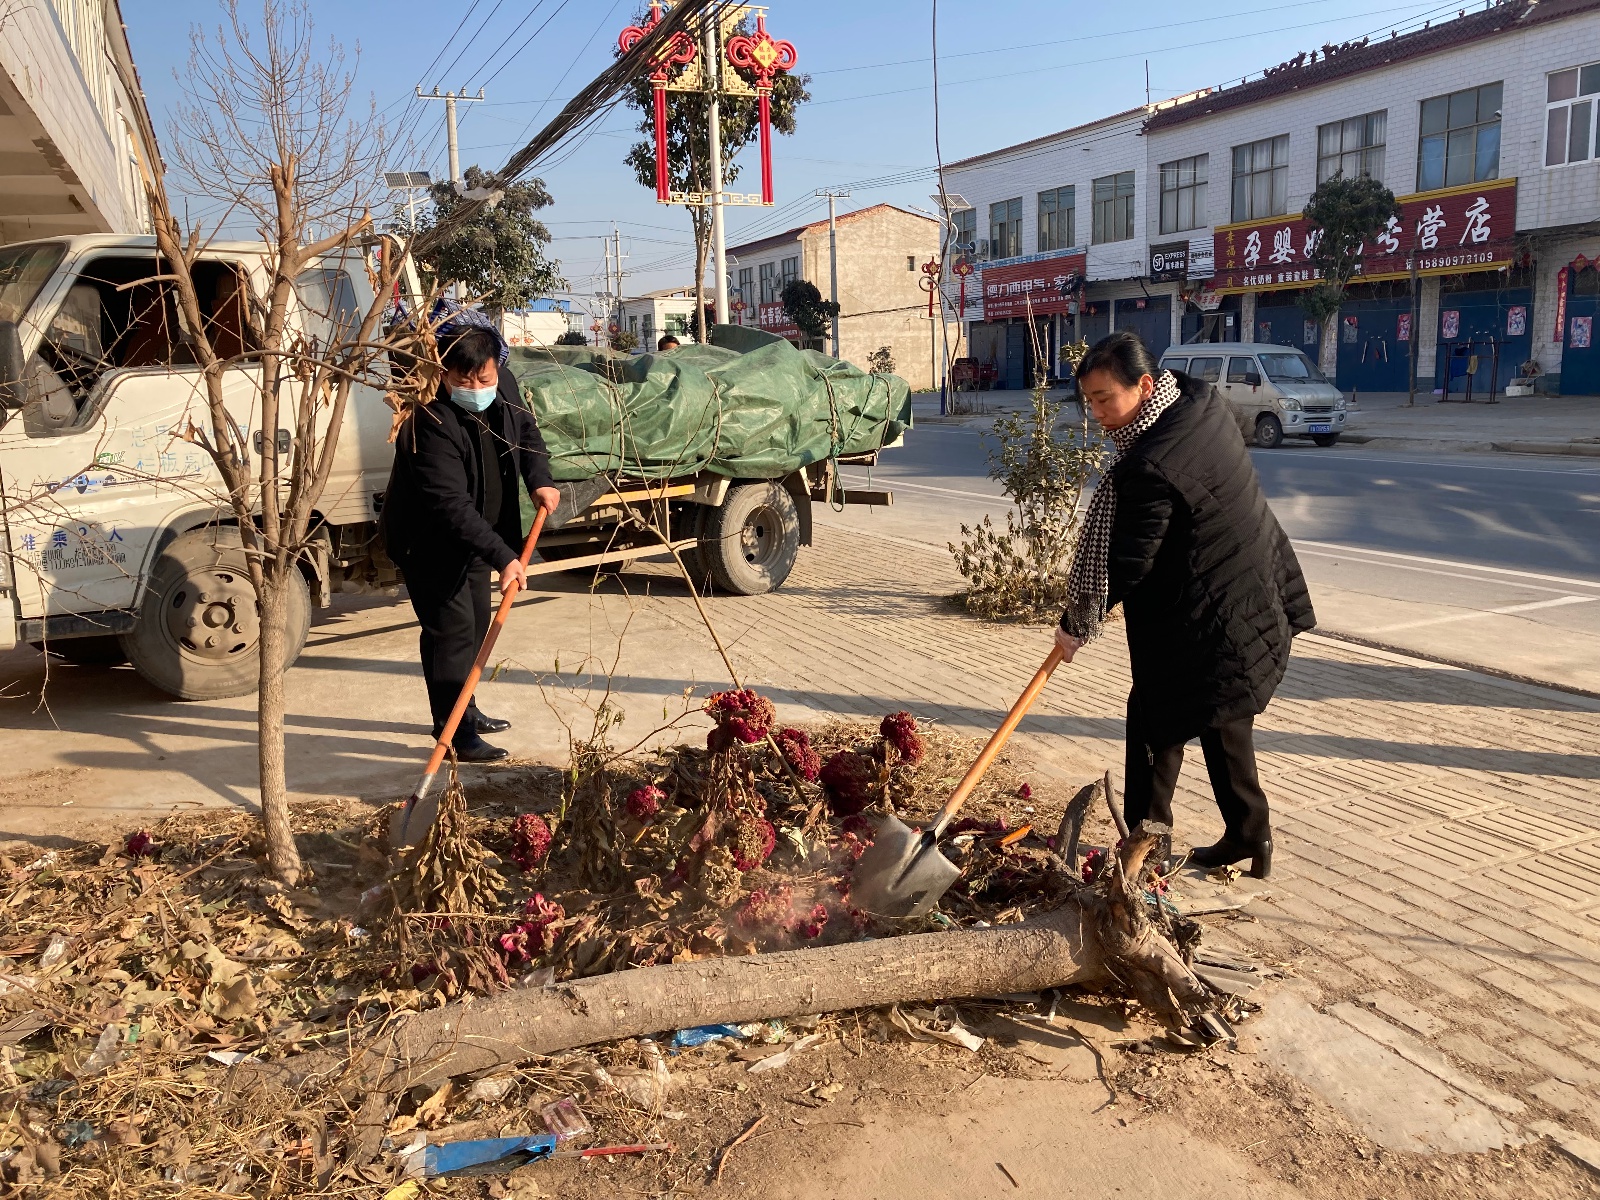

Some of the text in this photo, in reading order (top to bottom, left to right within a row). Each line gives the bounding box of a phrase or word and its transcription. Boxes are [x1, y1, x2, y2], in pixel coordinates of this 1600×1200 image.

[1243, 197, 1492, 271] 孕婴专营店
[1165, 250, 1186, 259] EXPRESS
[1419, 252, 1493, 269] 15890973109
